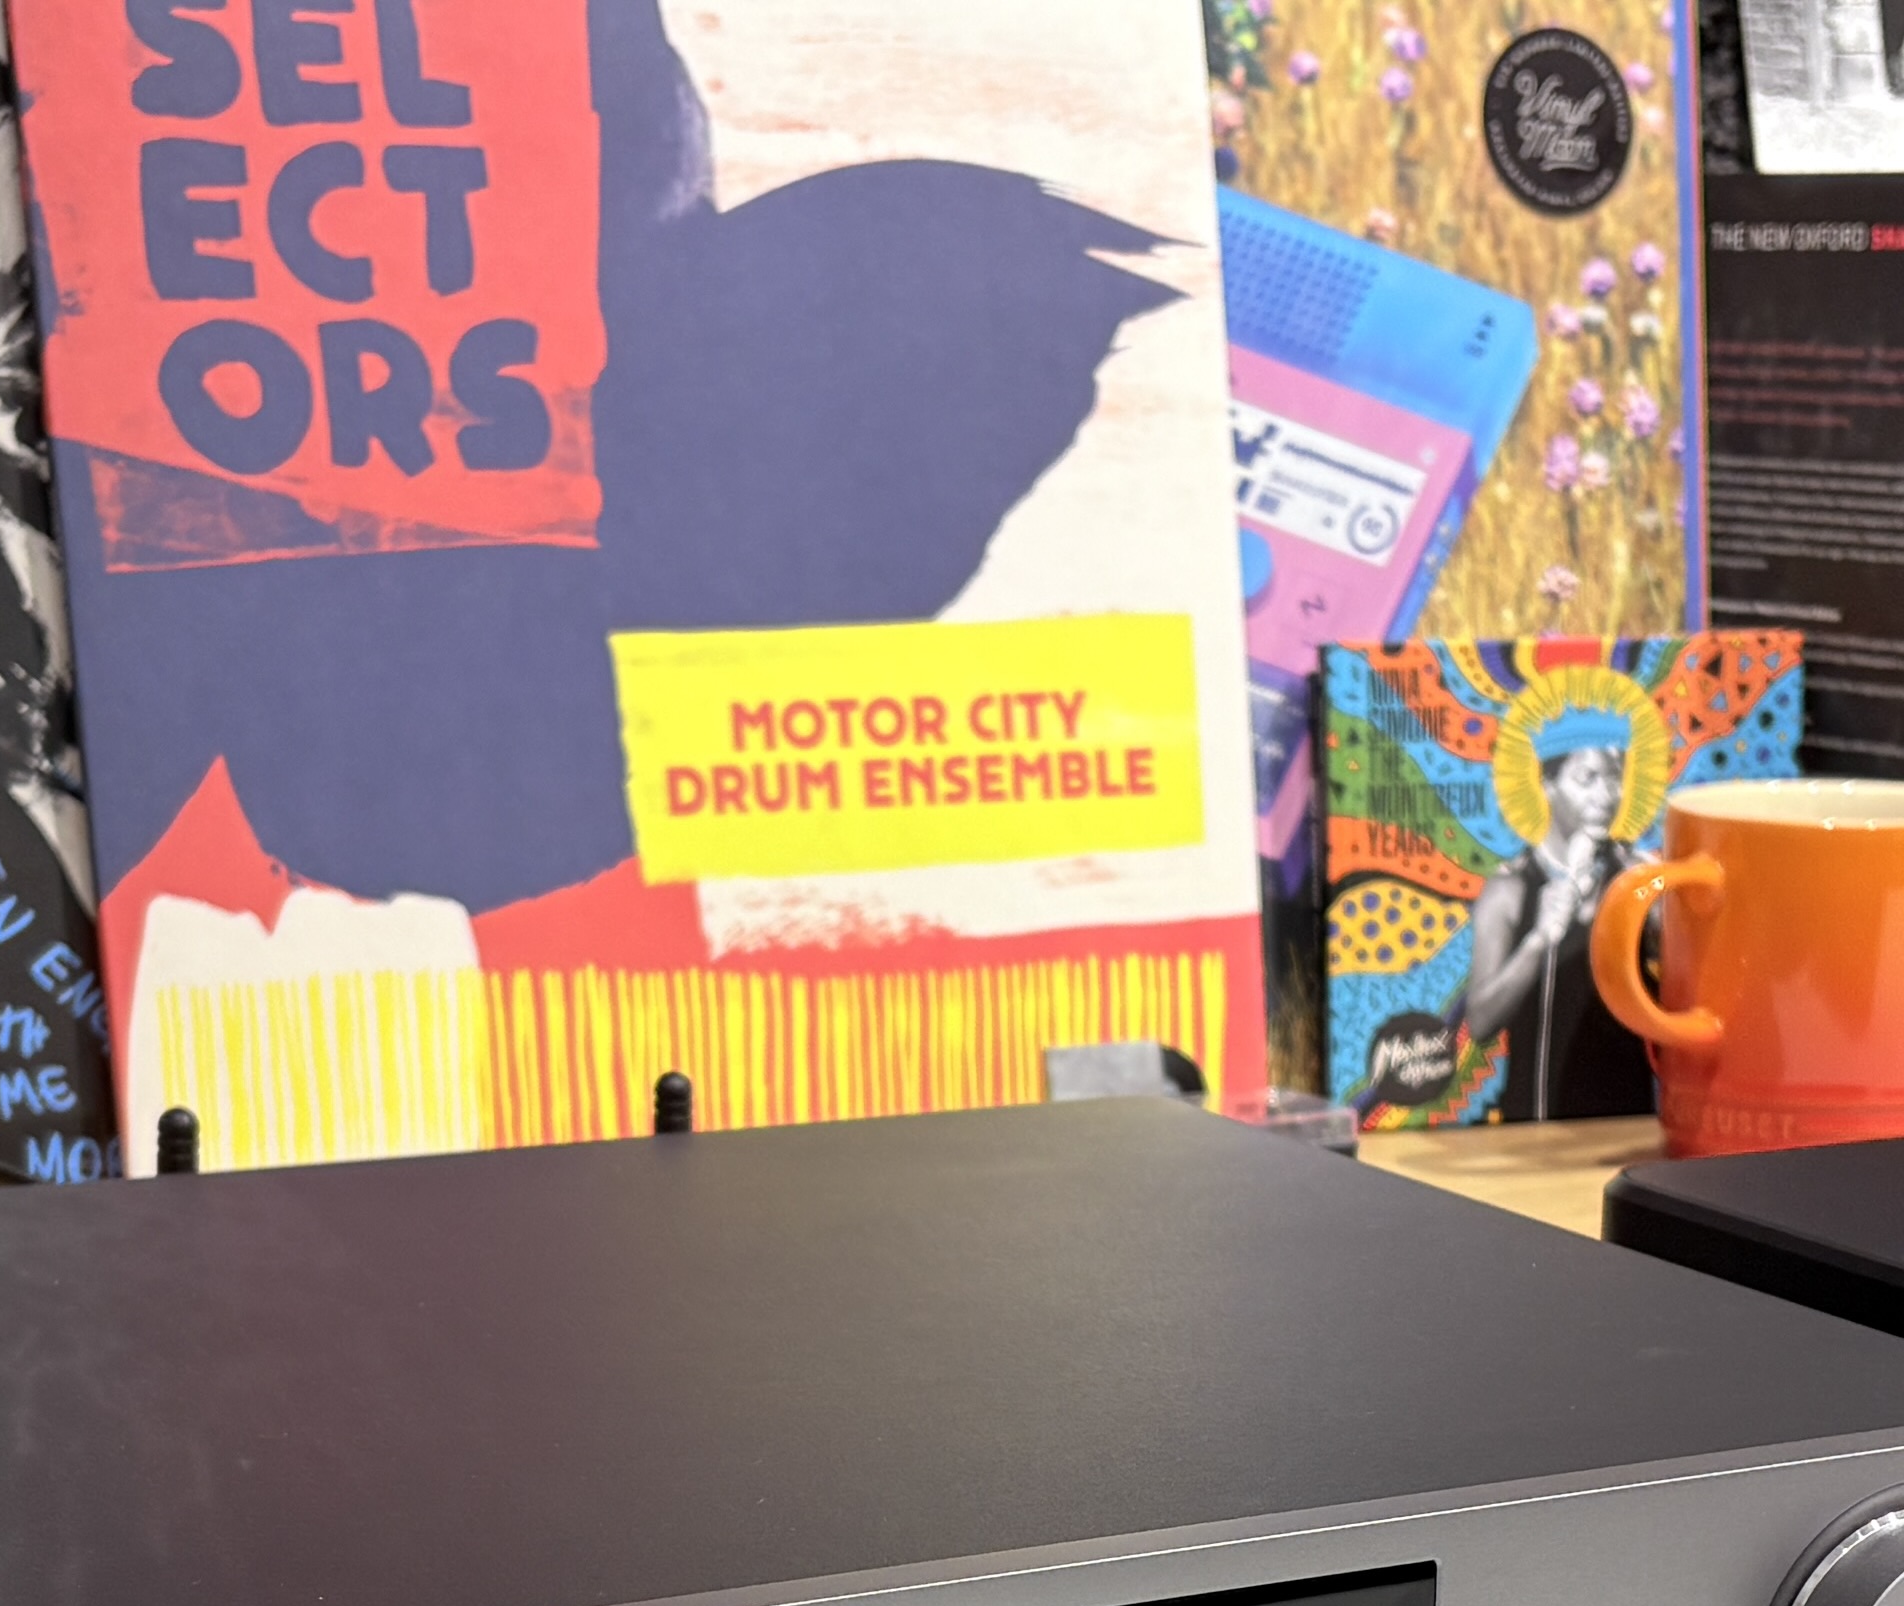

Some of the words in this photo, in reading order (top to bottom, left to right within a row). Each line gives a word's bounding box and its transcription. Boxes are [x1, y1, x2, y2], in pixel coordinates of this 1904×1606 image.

[124, 0, 473, 127] SEL
[140, 137, 488, 303] ECT
[158, 318, 552, 478] ORS
[665, 761, 841, 817] DRUM
[862, 747, 1157, 809] ENSEMBLE
[729, 696, 949, 752] MOTOR
[968, 690, 1086, 741] CITY
